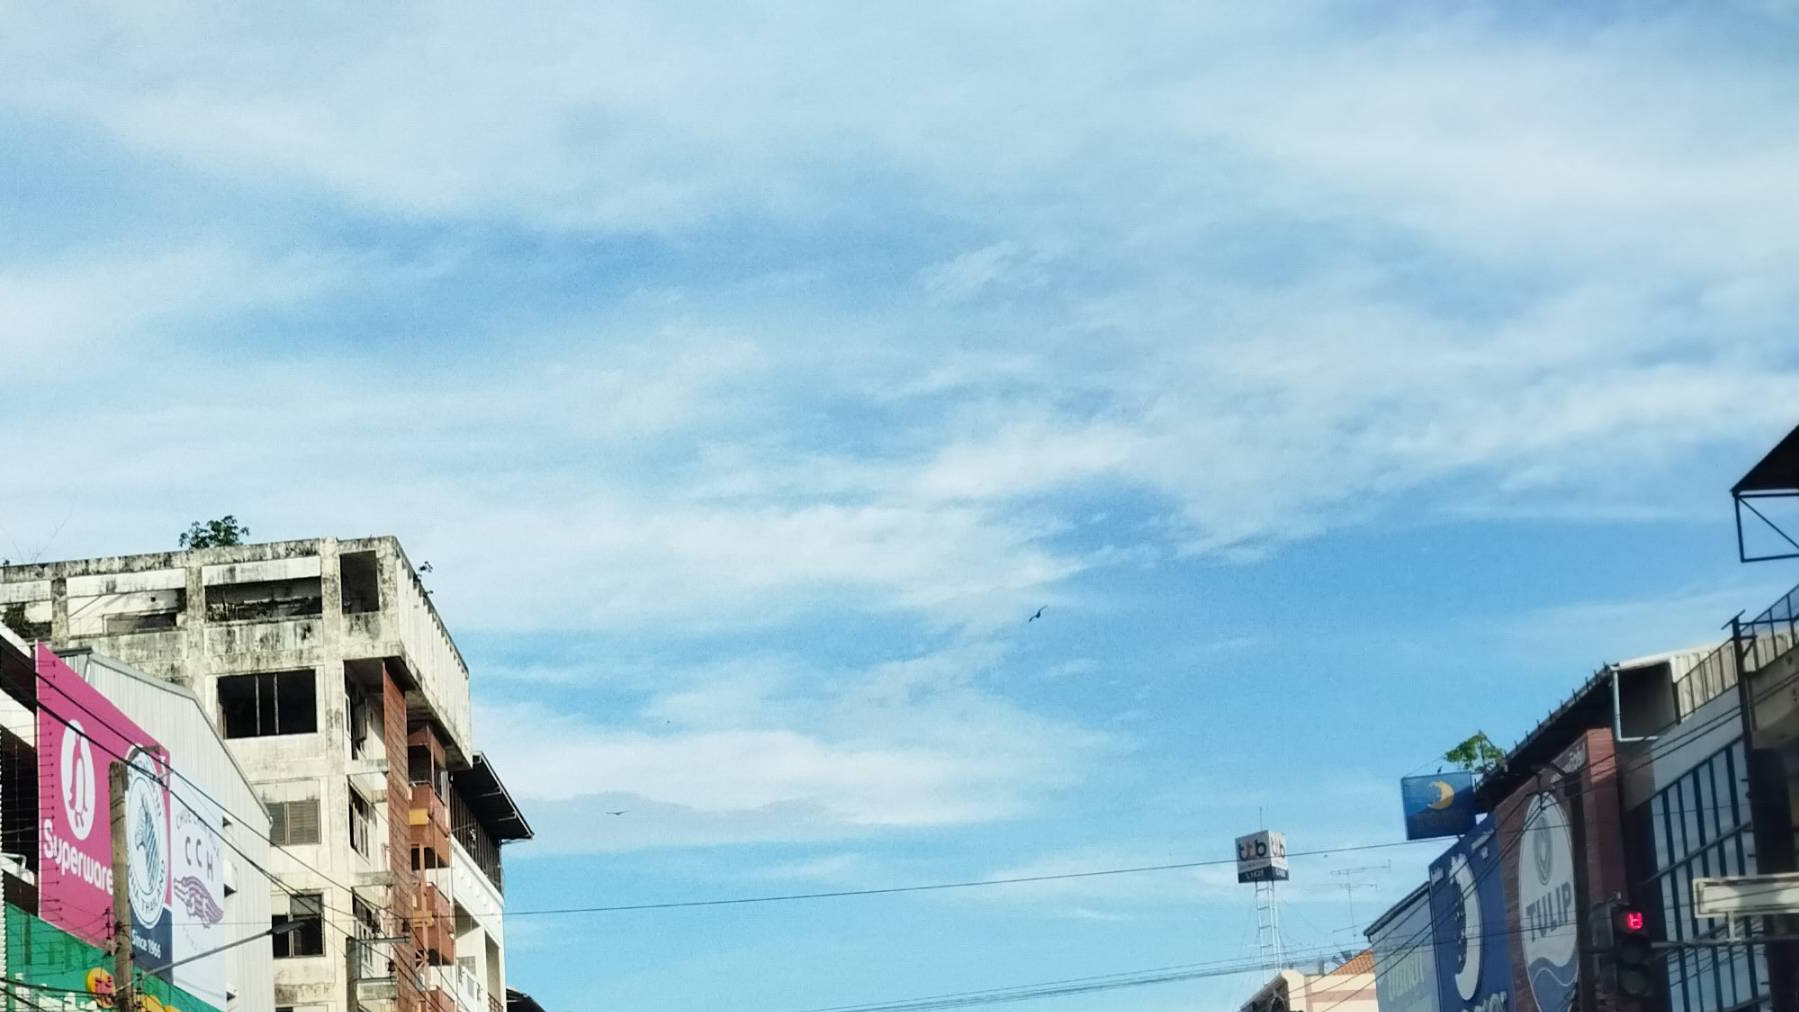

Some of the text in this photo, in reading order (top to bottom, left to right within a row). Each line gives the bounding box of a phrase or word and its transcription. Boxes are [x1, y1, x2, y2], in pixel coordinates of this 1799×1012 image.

[43, 818, 114, 896] Superware
[131, 929, 147, 949] Since
[1525, 881, 1572, 942] TULIP
